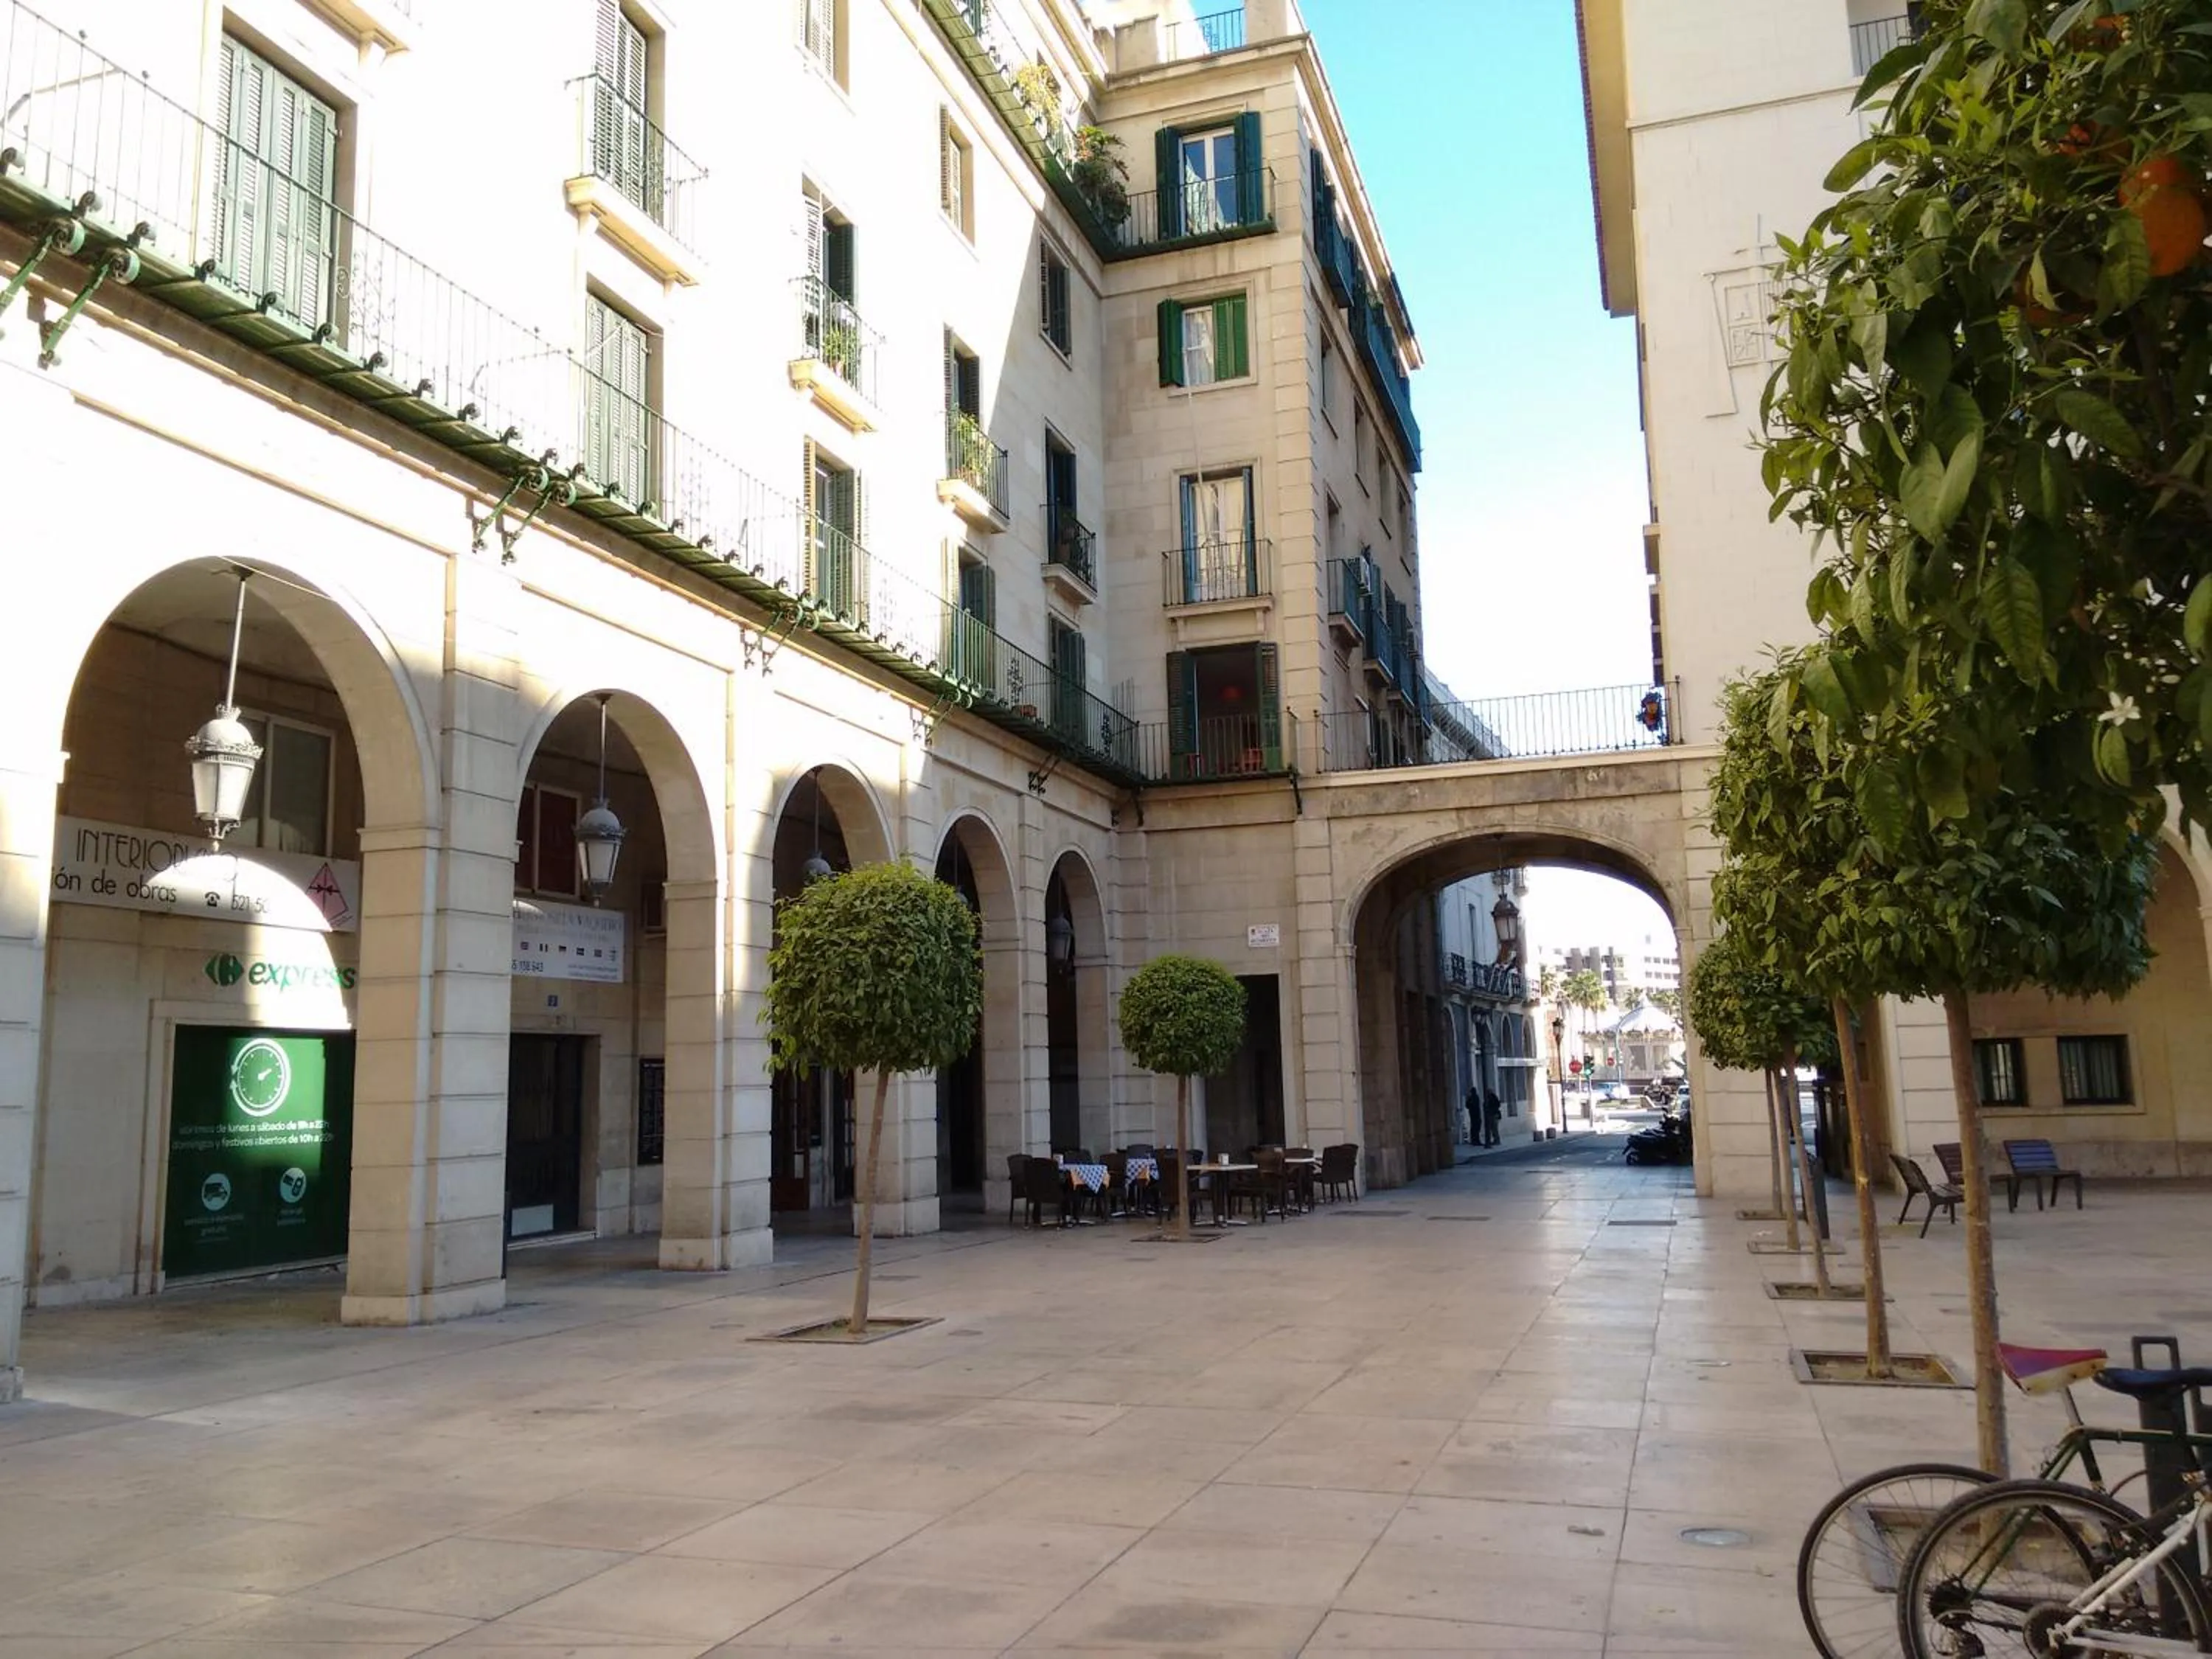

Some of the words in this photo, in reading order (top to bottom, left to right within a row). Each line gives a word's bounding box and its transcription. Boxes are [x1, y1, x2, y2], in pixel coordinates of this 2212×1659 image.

[91, 866, 117, 895] de
[126, 874, 177, 903] obras
[248, 961, 356, 992] express
[228, 1123, 250, 1132] lunes
[222, 1137, 253, 1148] festivos
[254, 1135, 287, 1146] abiertos
[288, 1134, 298, 1144] de
